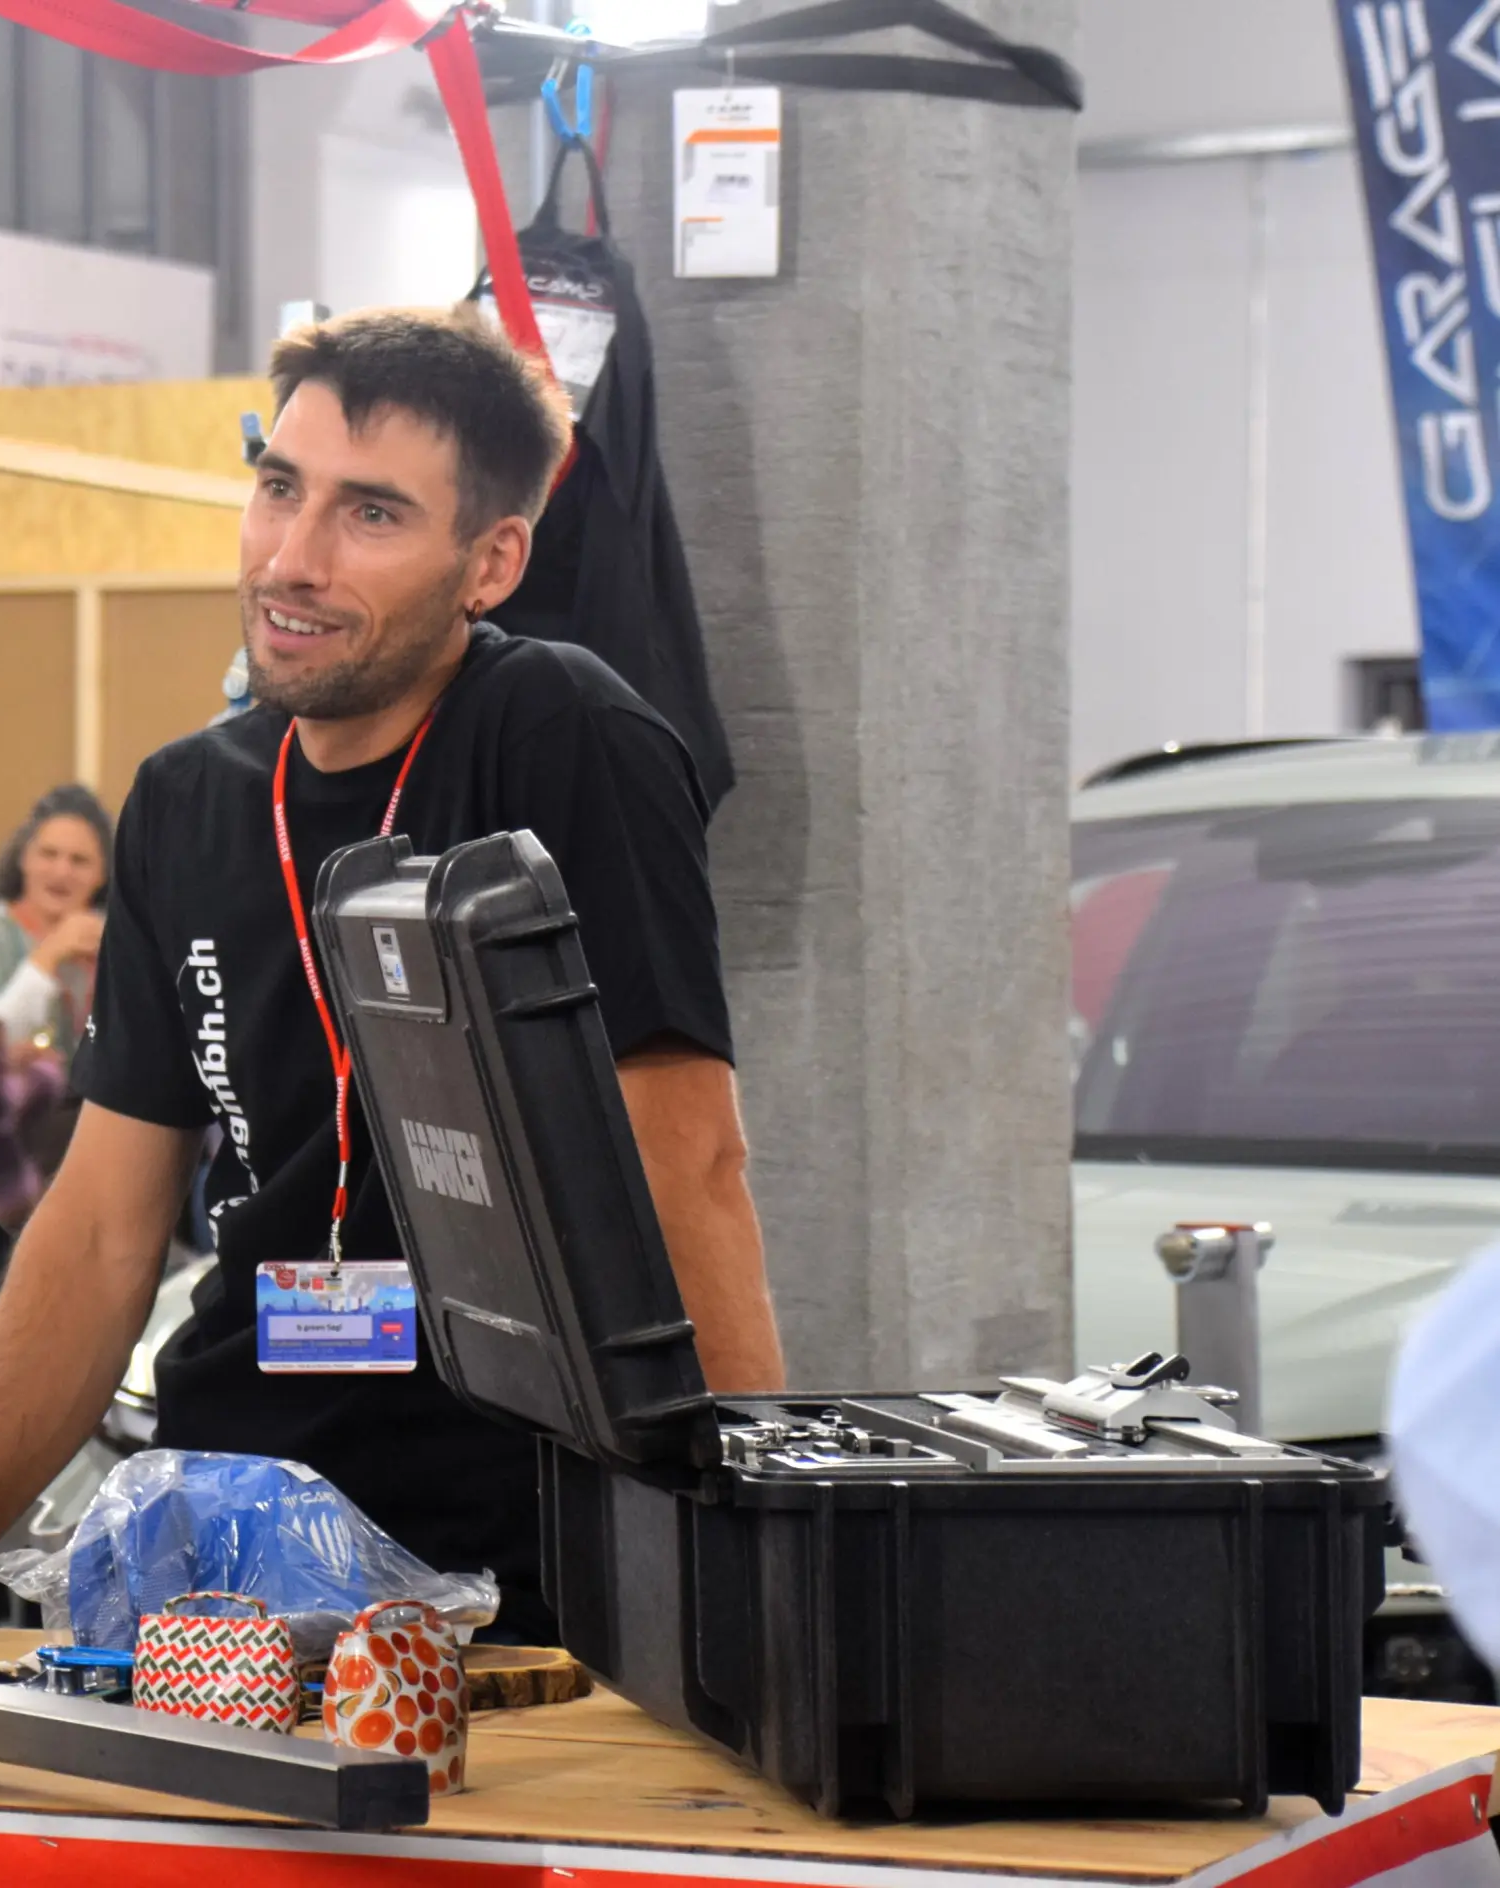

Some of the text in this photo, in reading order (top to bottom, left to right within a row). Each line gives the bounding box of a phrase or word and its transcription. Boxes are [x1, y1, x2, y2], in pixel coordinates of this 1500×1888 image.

[527, 275, 604, 300] CAMP
[1354, 0, 1492, 521] GARAGE
[298, 937, 320, 1000] RAIFFEISEN
